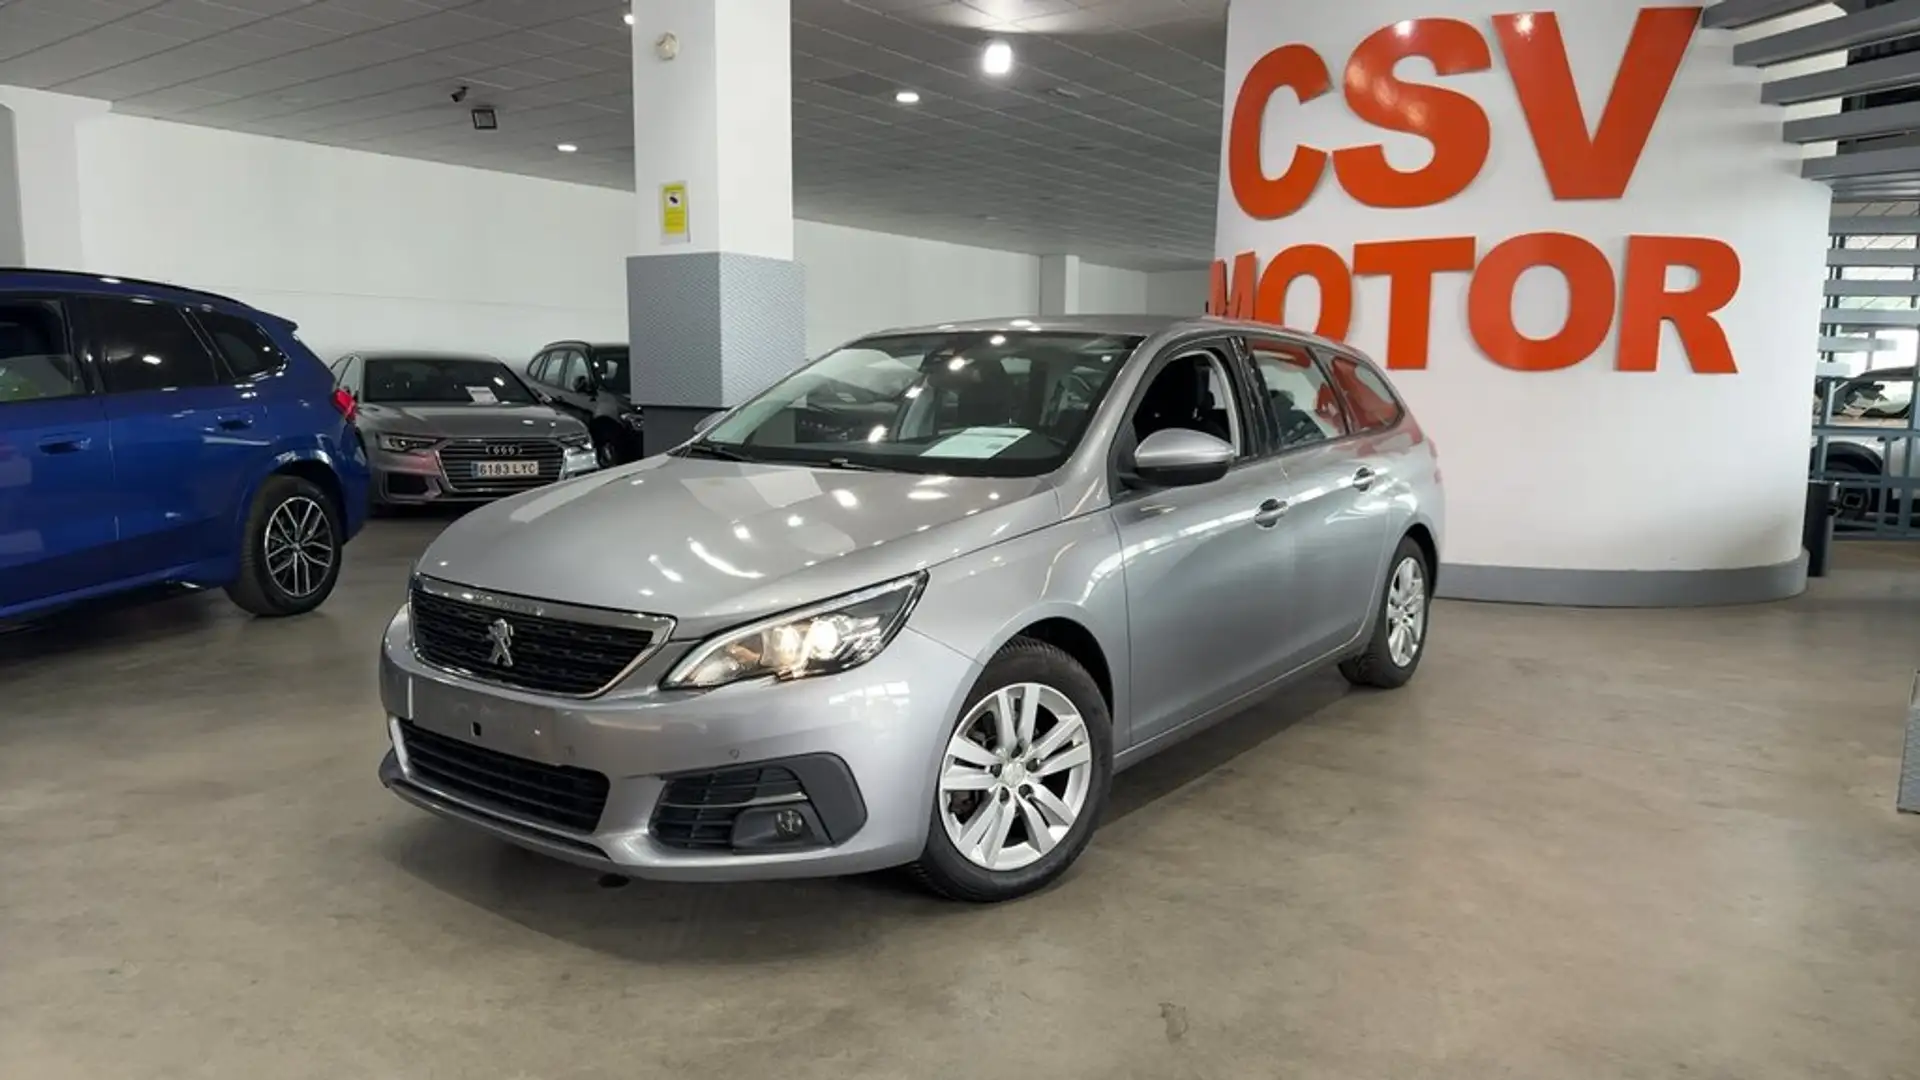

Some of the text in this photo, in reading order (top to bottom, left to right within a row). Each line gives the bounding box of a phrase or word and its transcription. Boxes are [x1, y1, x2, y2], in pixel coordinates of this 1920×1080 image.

[1229, 7, 1702, 220] CSV
[1208, 232, 1740, 374] MOTOR
[480, 463, 536, 476] 6183 LYC
